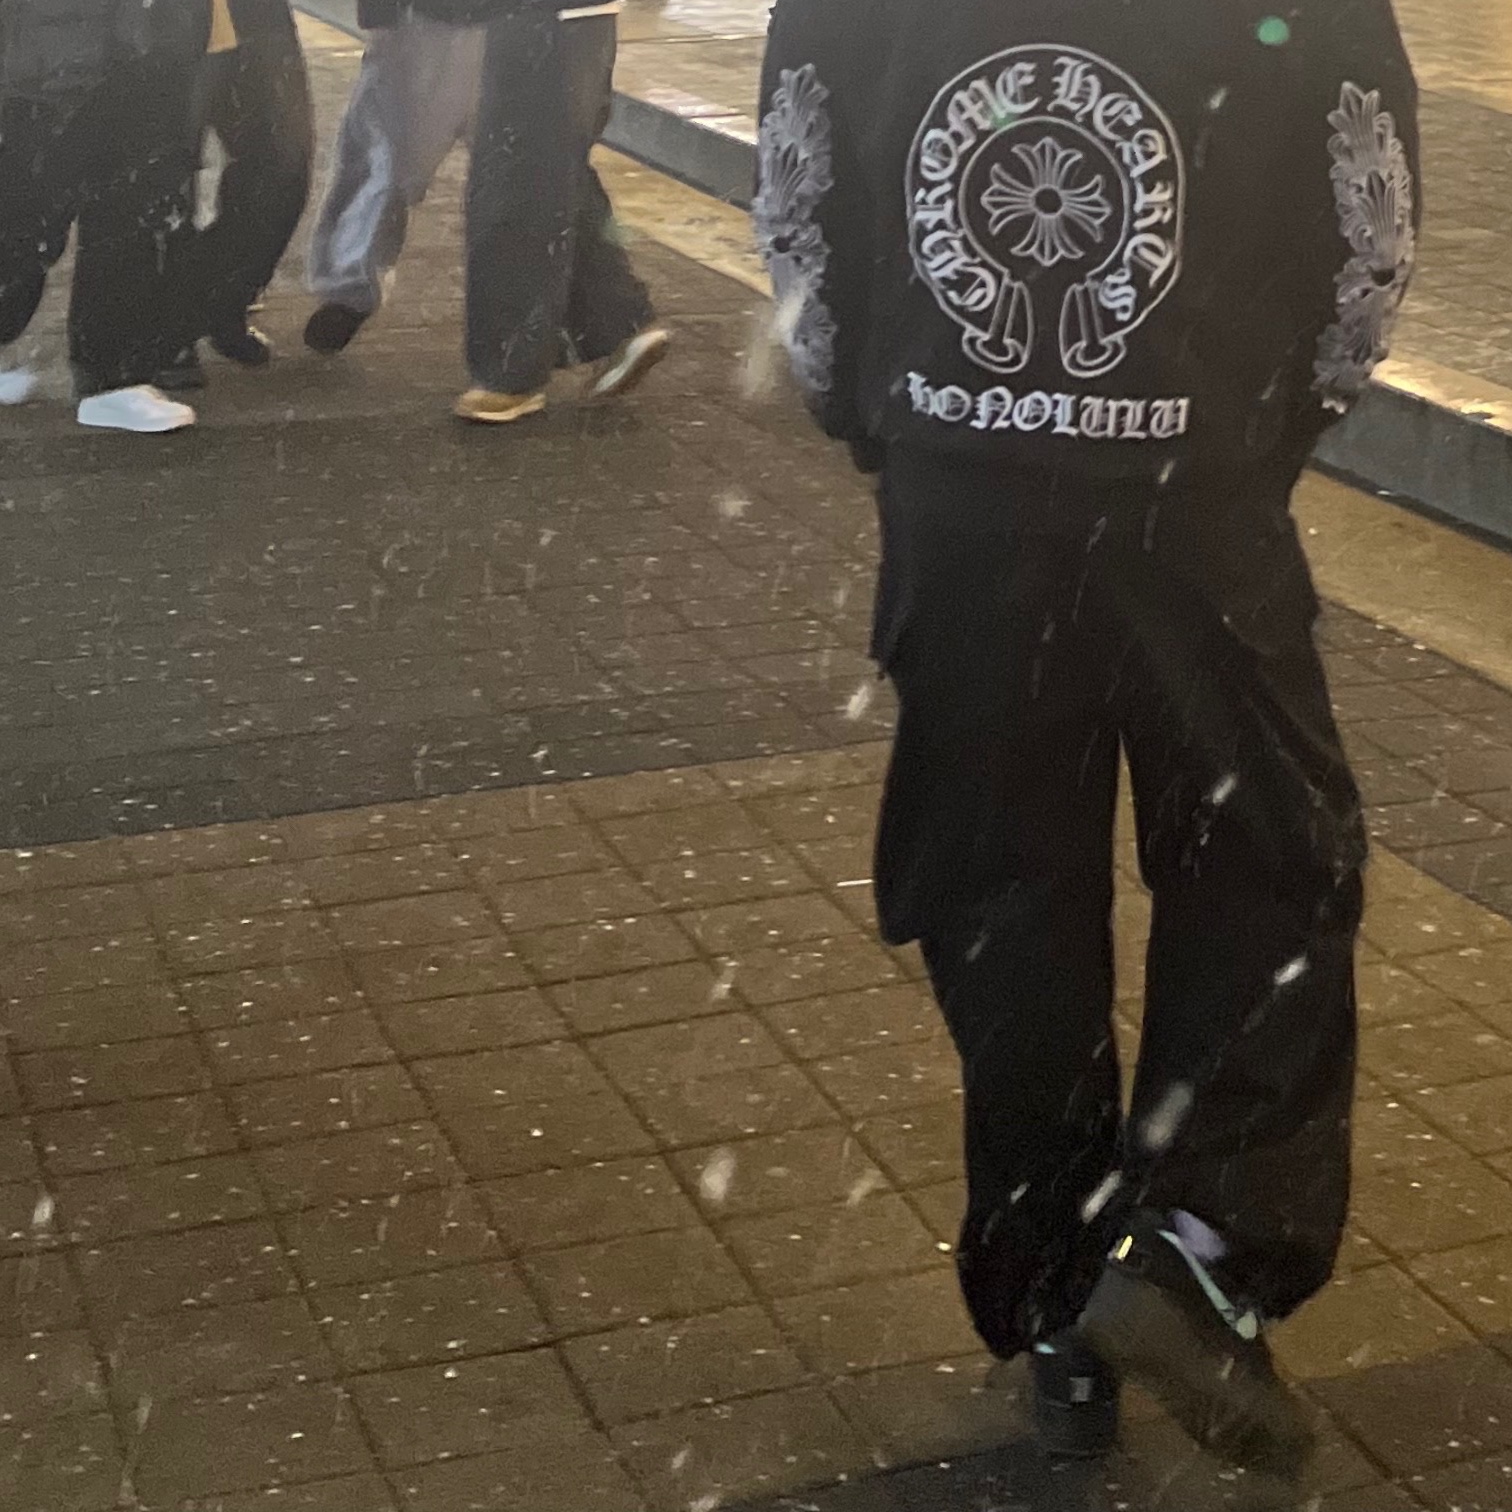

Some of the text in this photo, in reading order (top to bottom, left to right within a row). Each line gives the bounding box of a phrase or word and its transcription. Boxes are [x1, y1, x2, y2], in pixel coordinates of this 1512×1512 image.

[914, 54, 1178, 323] CHROME HEARTS
[907, 372, 1190, 440] HONOLULU
